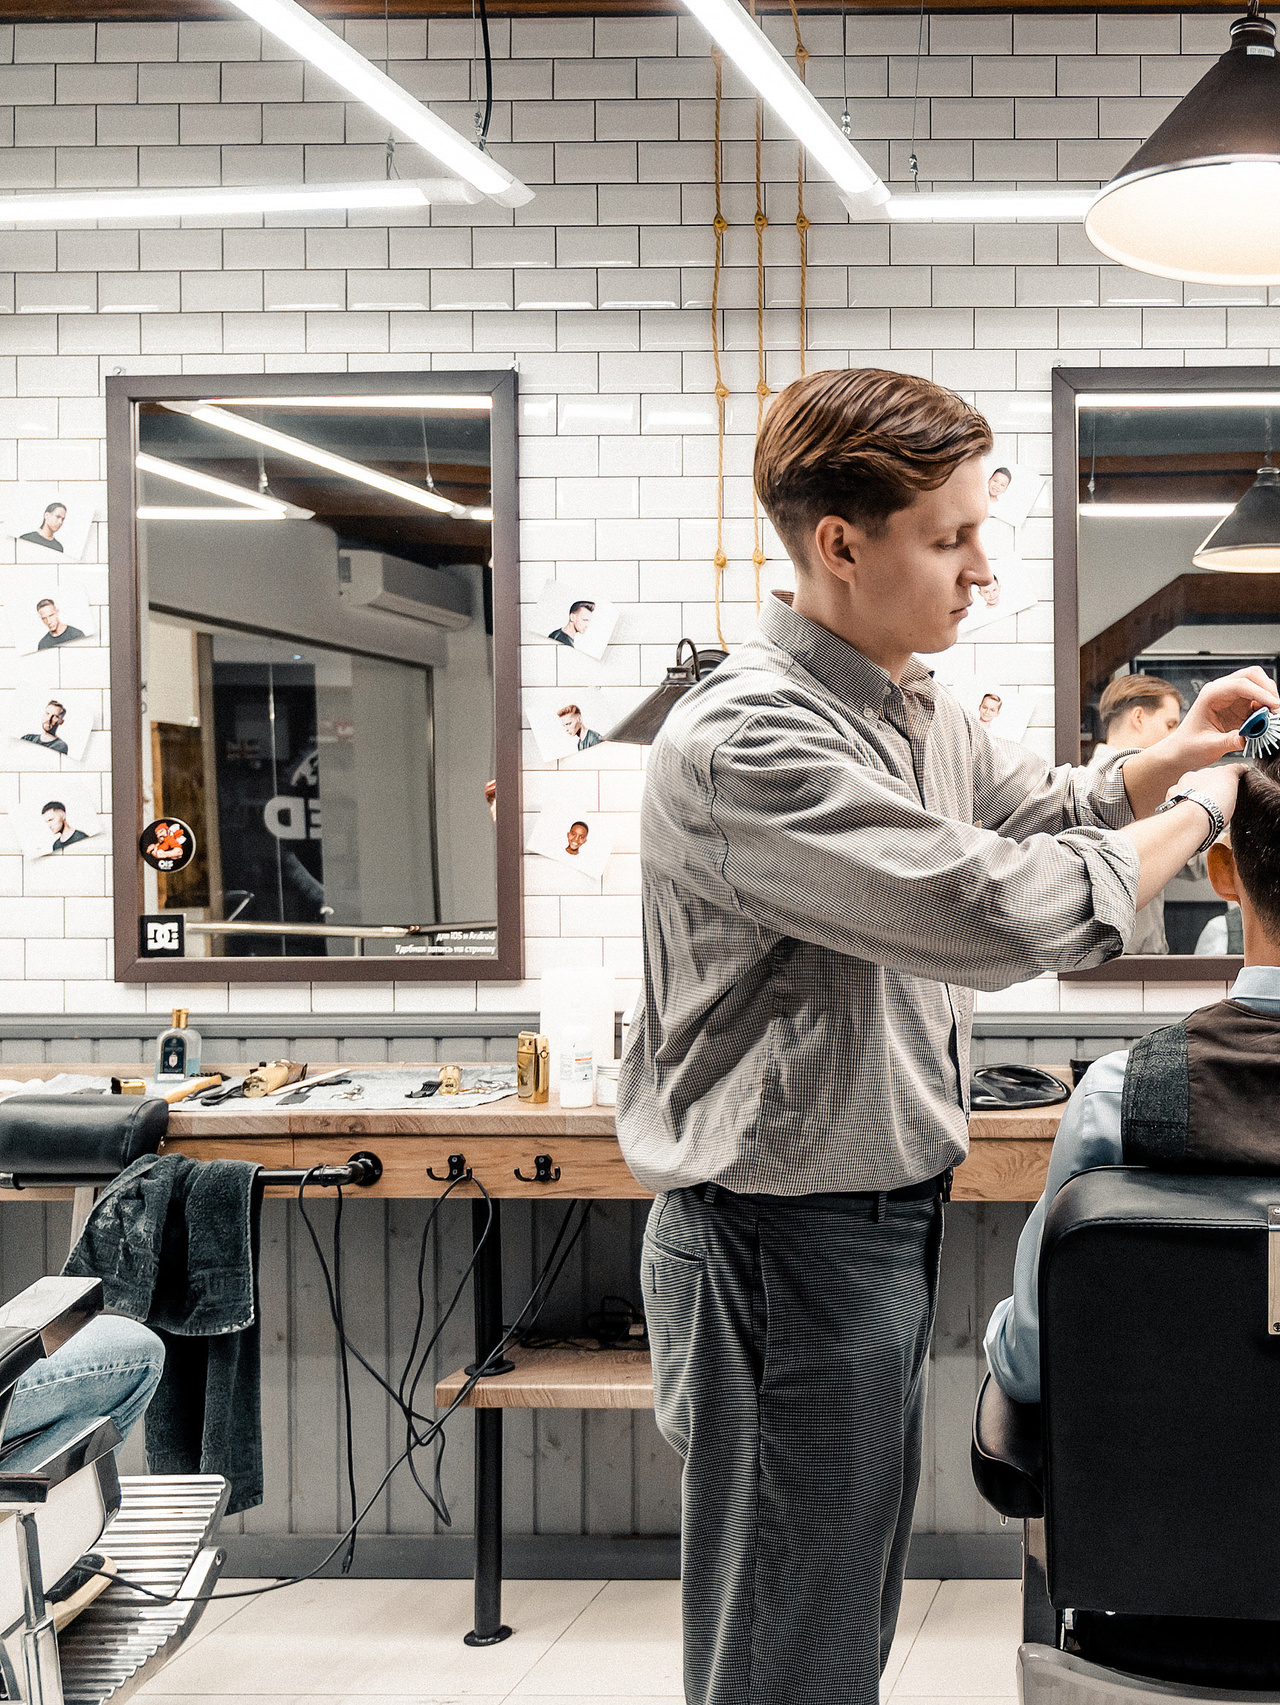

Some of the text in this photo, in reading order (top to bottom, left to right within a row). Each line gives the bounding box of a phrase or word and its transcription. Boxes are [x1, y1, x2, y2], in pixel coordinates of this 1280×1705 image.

[147, 922, 179, 950] DC
[450, 931, 463, 940] iOS
[469, 931, 496, 940] Android
